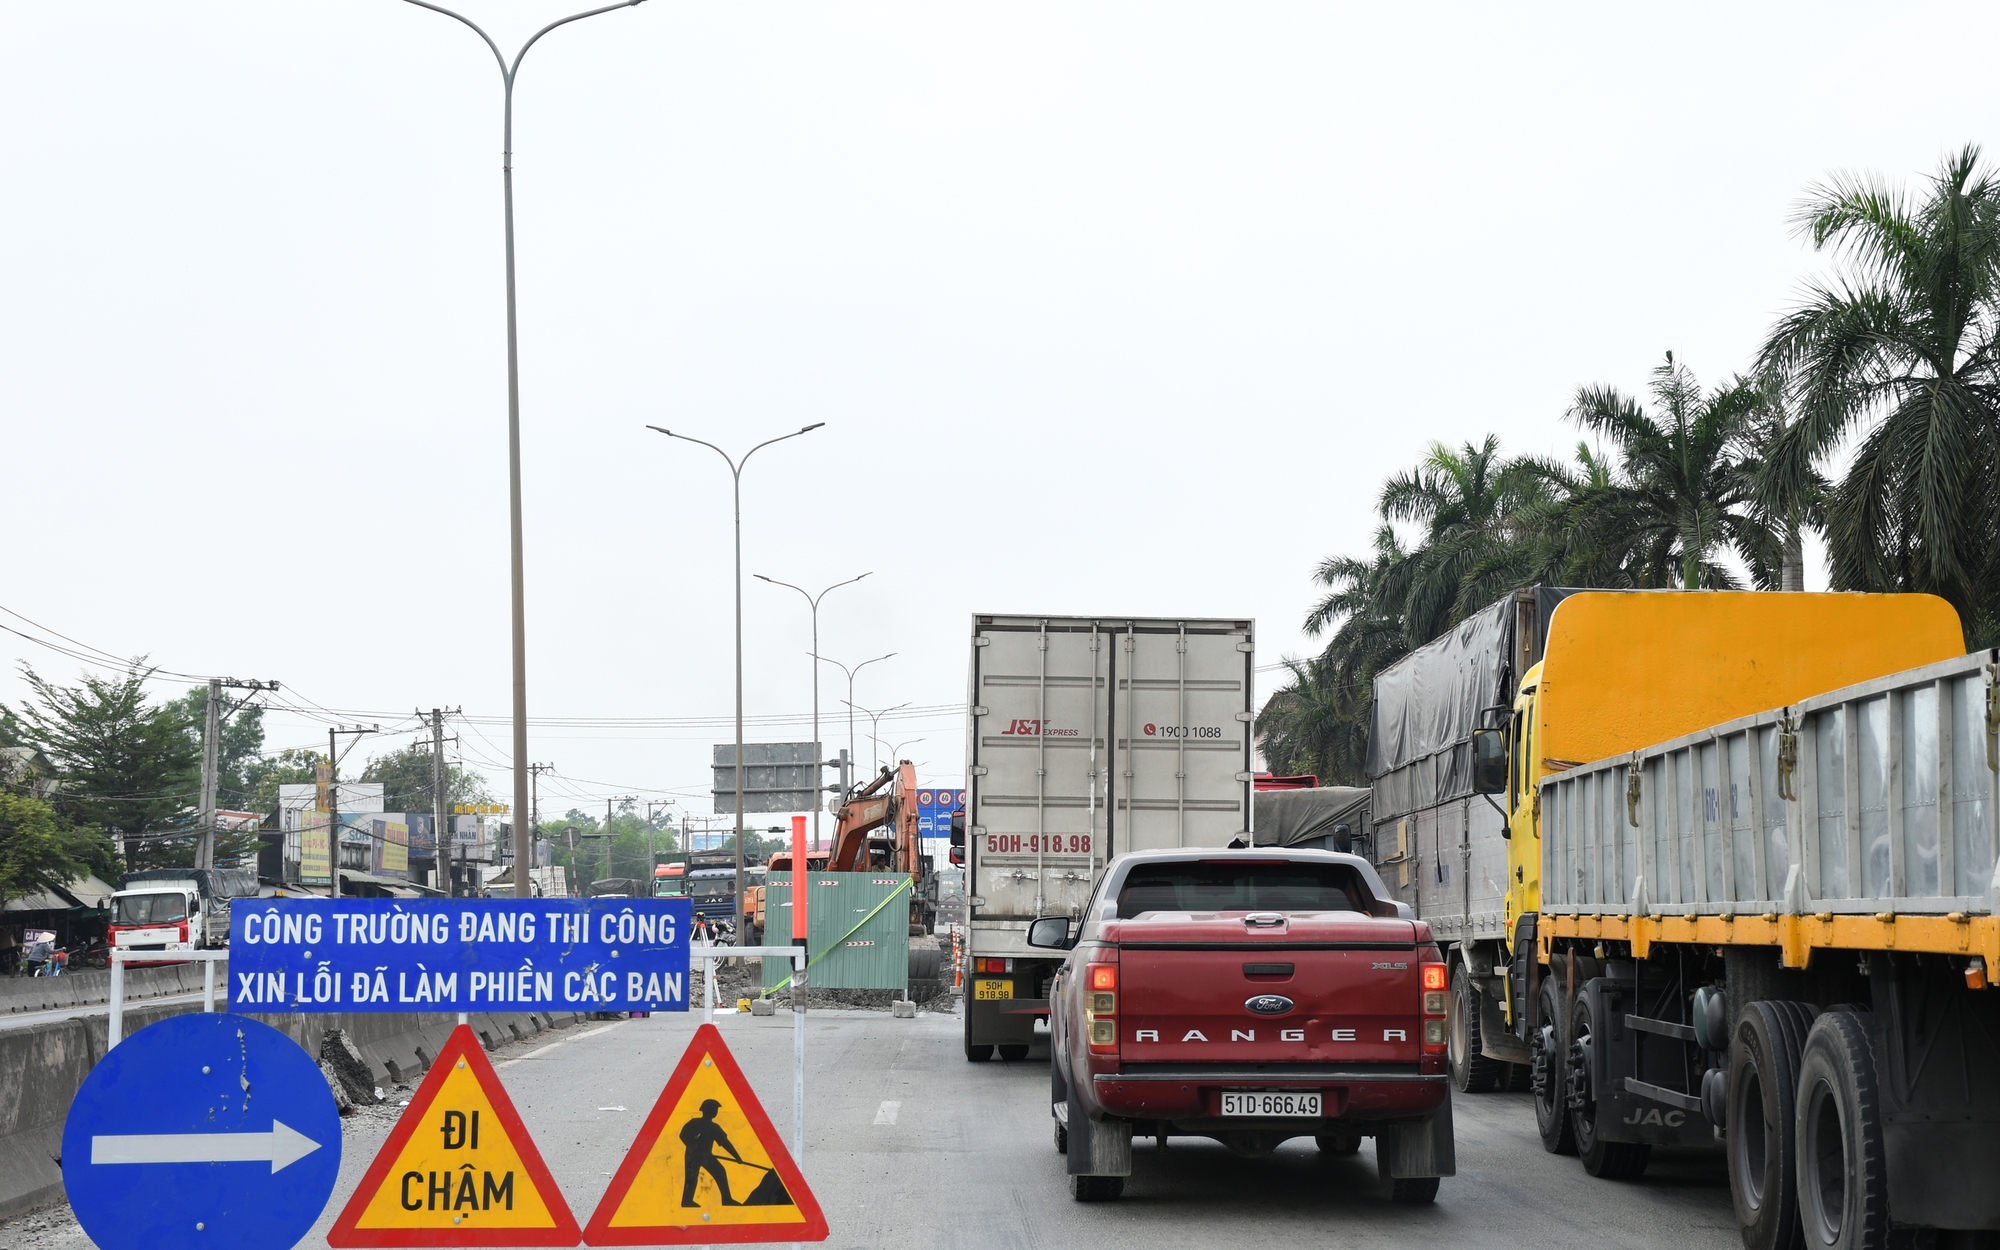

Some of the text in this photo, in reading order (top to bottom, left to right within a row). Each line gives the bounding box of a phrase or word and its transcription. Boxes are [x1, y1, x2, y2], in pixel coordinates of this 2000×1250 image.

[1043, 728, 1078, 736] EXPRESS
[1159, 726, 1222, 738] 1900 1088
[922, 794, 930, 802] 60
[941, 794, 949, 802] 60
[987, 834, 1091, 853] 50H-918.98
[244, 904, 675, 944] CÔNG TRƯỜNG ĐANG THI CÔNG
[1371, 962, 1407, 970] XLS
[237, 972, 286, 1003] XIN
[297, 960, 341, 1003] LỖI
[351, 965, 389, 1003] ĐÃ
[399, 963, 457, 1003] LÀM
[470, 958, 553, 1002] PHIỀN
[627, 971, 682, 1008] BẠN
[986, 981, 1003, 990] 50H
[979, 990, 1010, 999] 918.98
[1256, 998, 1284, 1011] Ford
[1136, 1028, 1406, 1042] RANGER
[1224, 1094, 1319, 1115] 51D-666.49
[1623, 1108, 1686, 1127] JAC
[440, 1111, 480, 1149] ĐI
[401, 1163, 514, 1218] CHẬM
